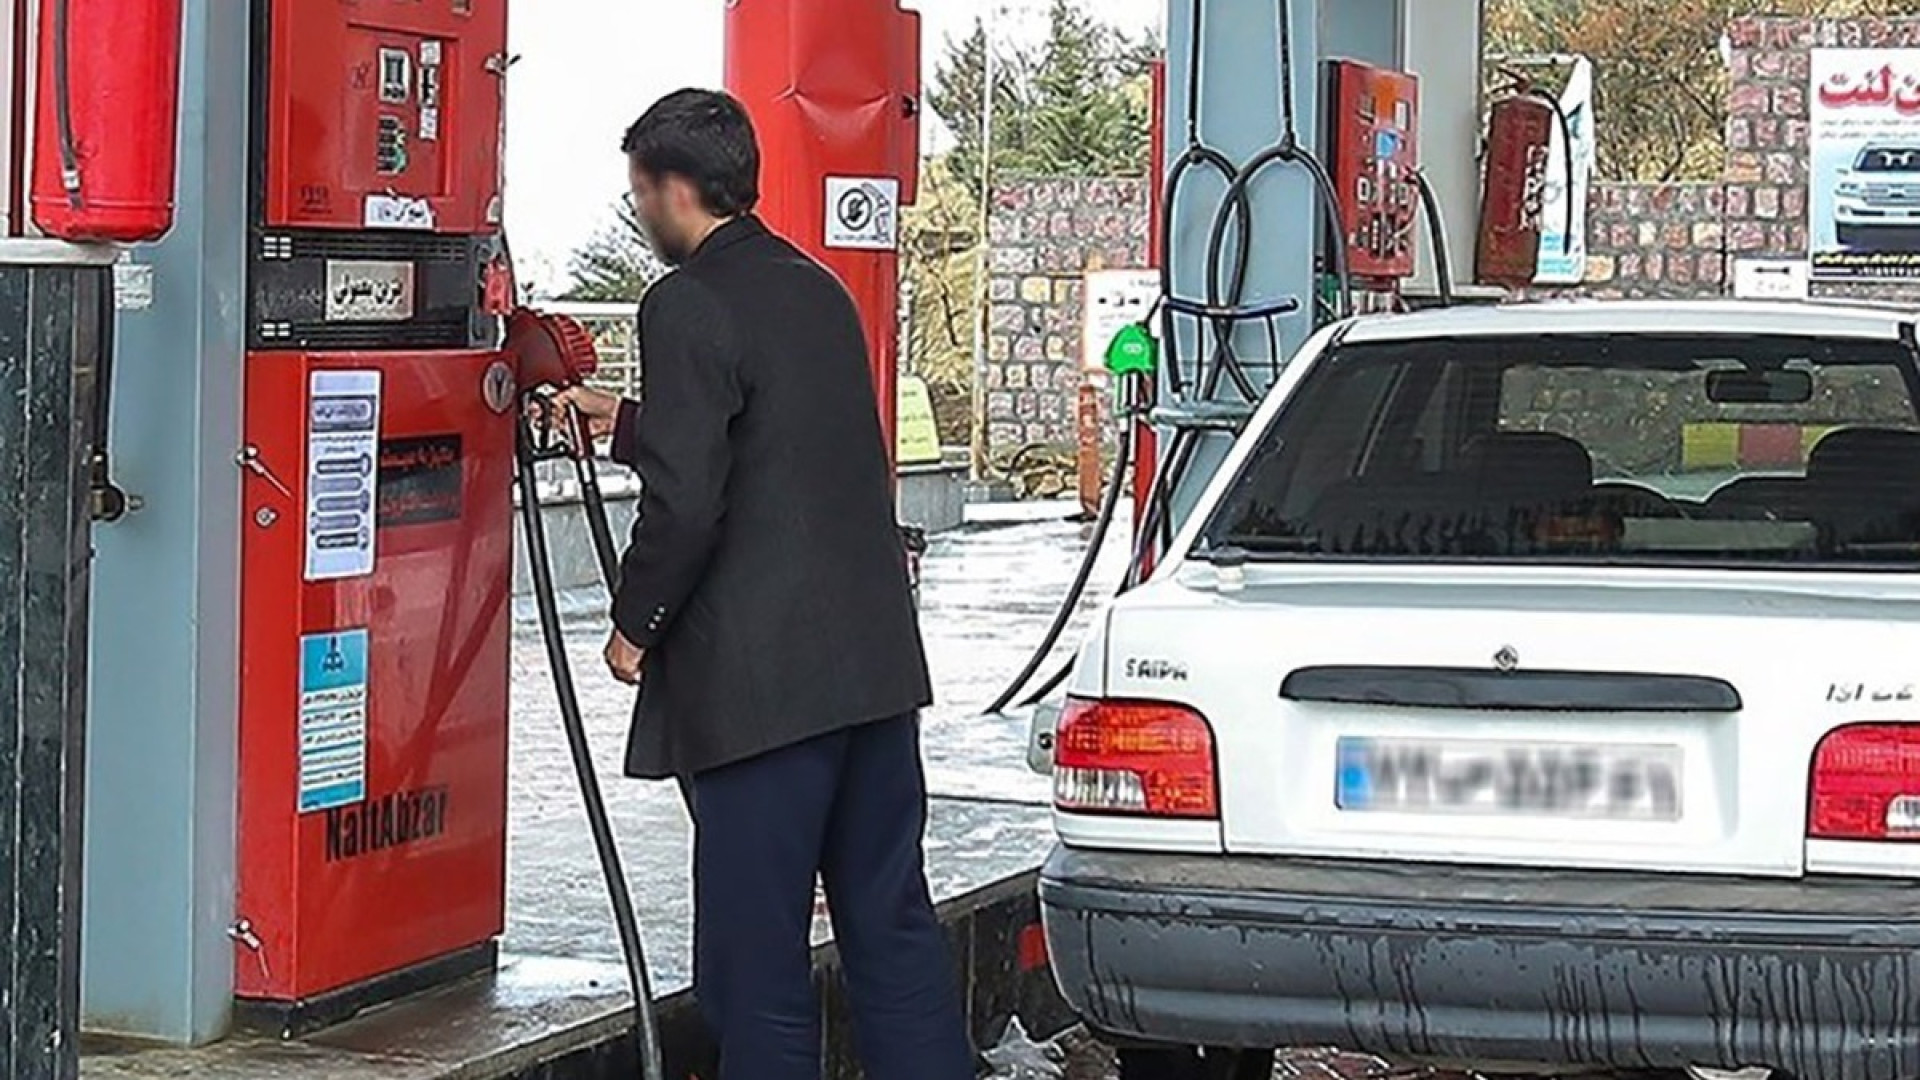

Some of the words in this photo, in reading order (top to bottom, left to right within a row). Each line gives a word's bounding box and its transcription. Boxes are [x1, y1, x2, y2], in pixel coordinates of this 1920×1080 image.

[1818, 64, 1892, 109] لنت
[334, 273, 373, 305] معمولی
[375, 277, 403, 305] بنزین
[1125, 658, 1188, 681] SAIPA
[327, 790, 446, 862] NaftAbzar
